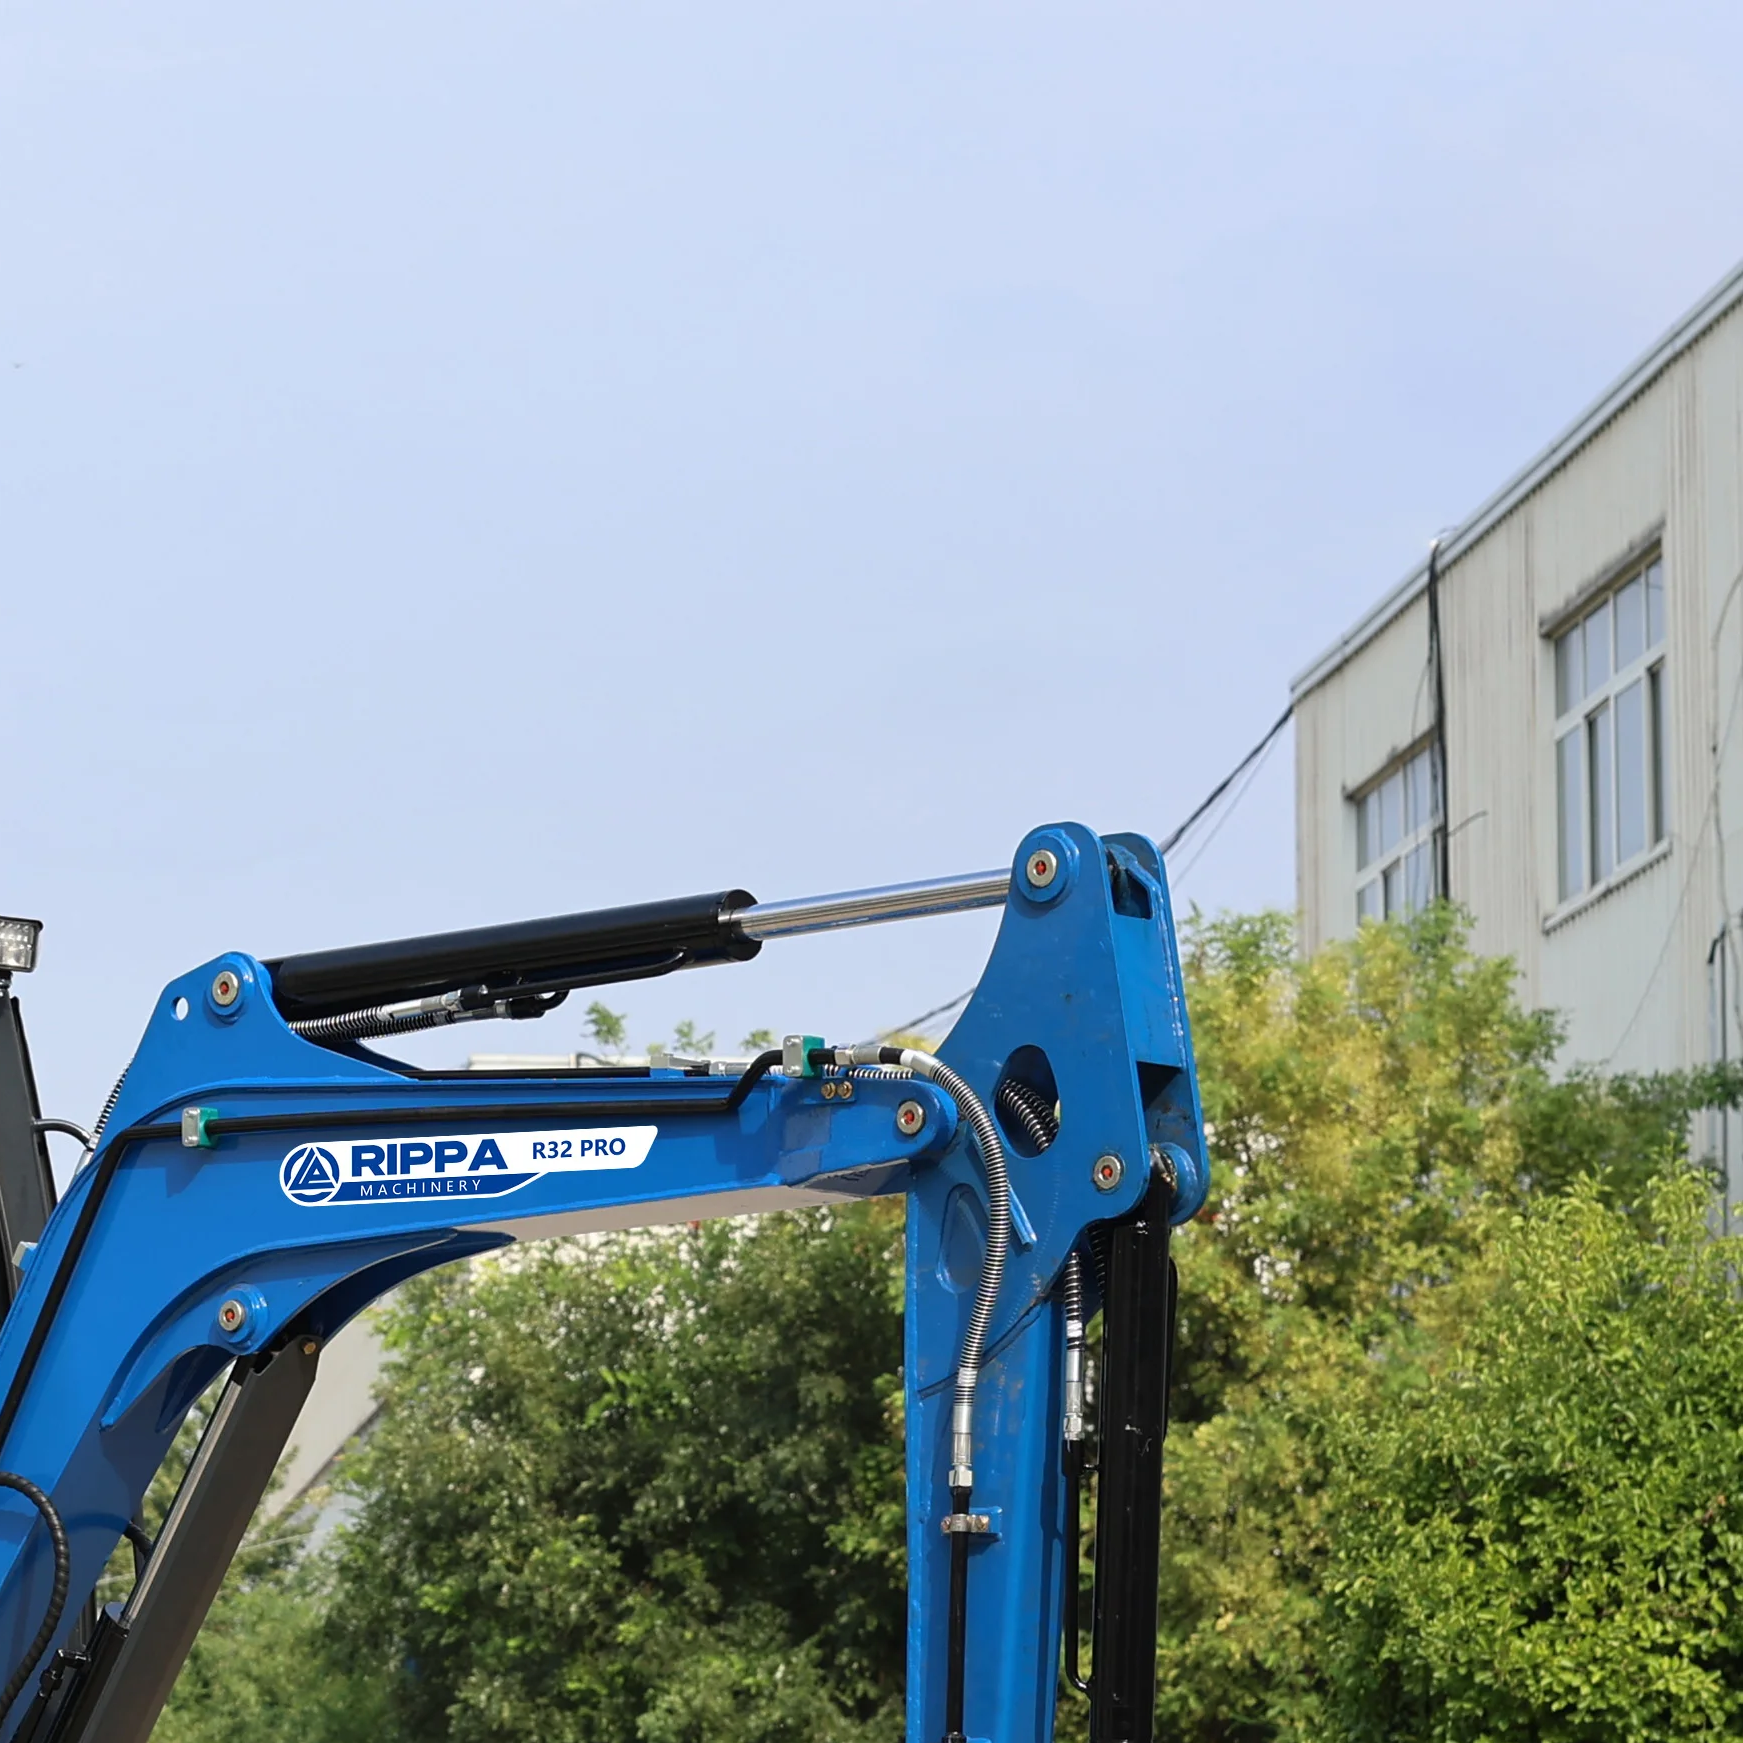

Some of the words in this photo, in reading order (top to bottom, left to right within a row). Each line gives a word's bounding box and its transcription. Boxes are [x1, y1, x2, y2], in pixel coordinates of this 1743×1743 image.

[352, 1139, 508, 1176] RIPPA
[532, 1139, 573, 1160] R32
[580, 1137, 626, 1158] PRO
[360, 1178, 482, 1197] MACHINERY
